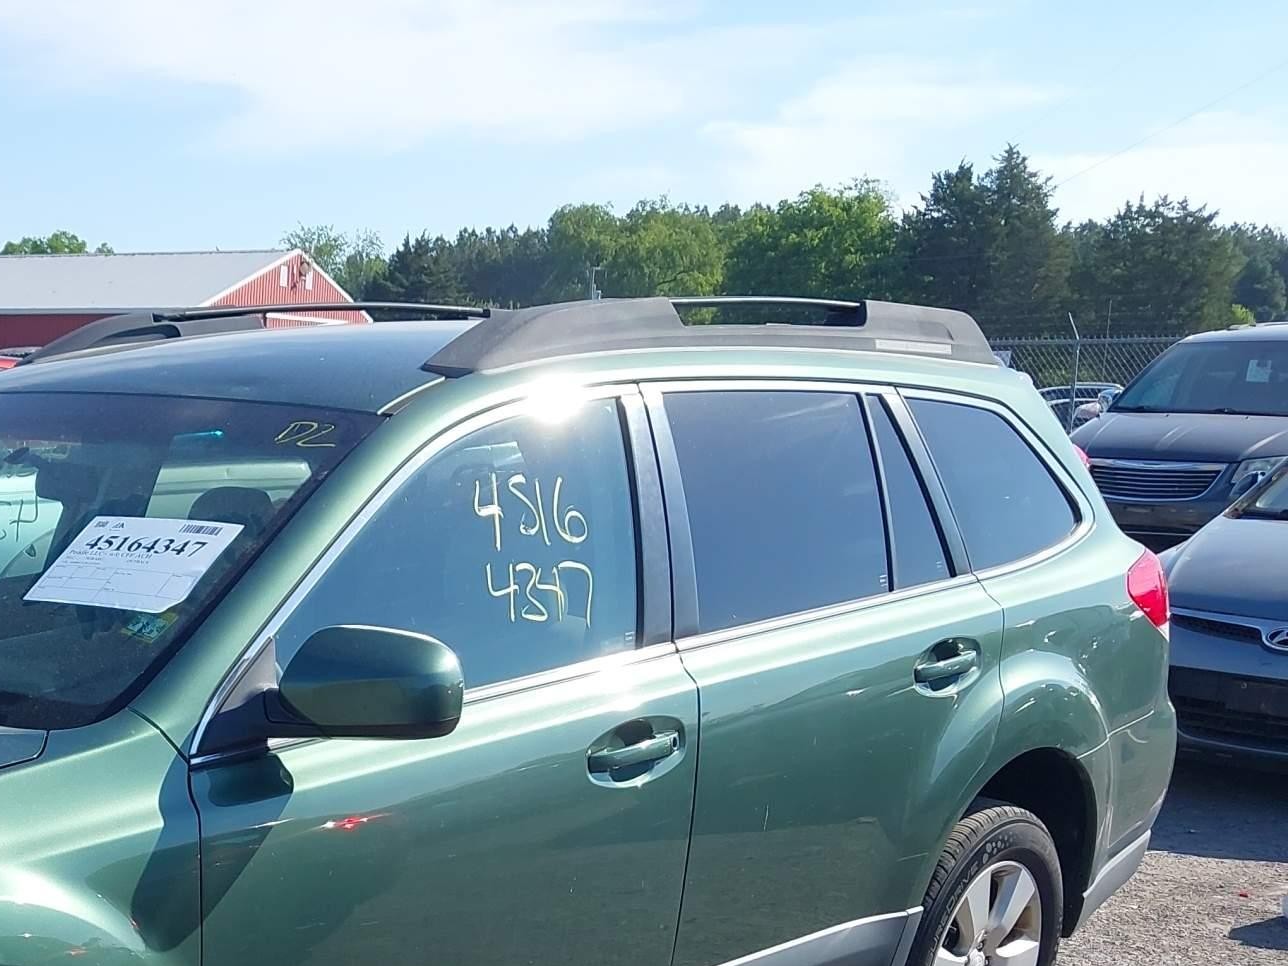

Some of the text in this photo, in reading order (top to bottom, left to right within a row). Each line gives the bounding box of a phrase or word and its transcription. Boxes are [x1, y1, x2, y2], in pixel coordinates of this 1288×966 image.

[85, 534, 209, 557] 45164347
[473, 472, 589, 551] 4516
[485, 560, 594, 628] 4347
